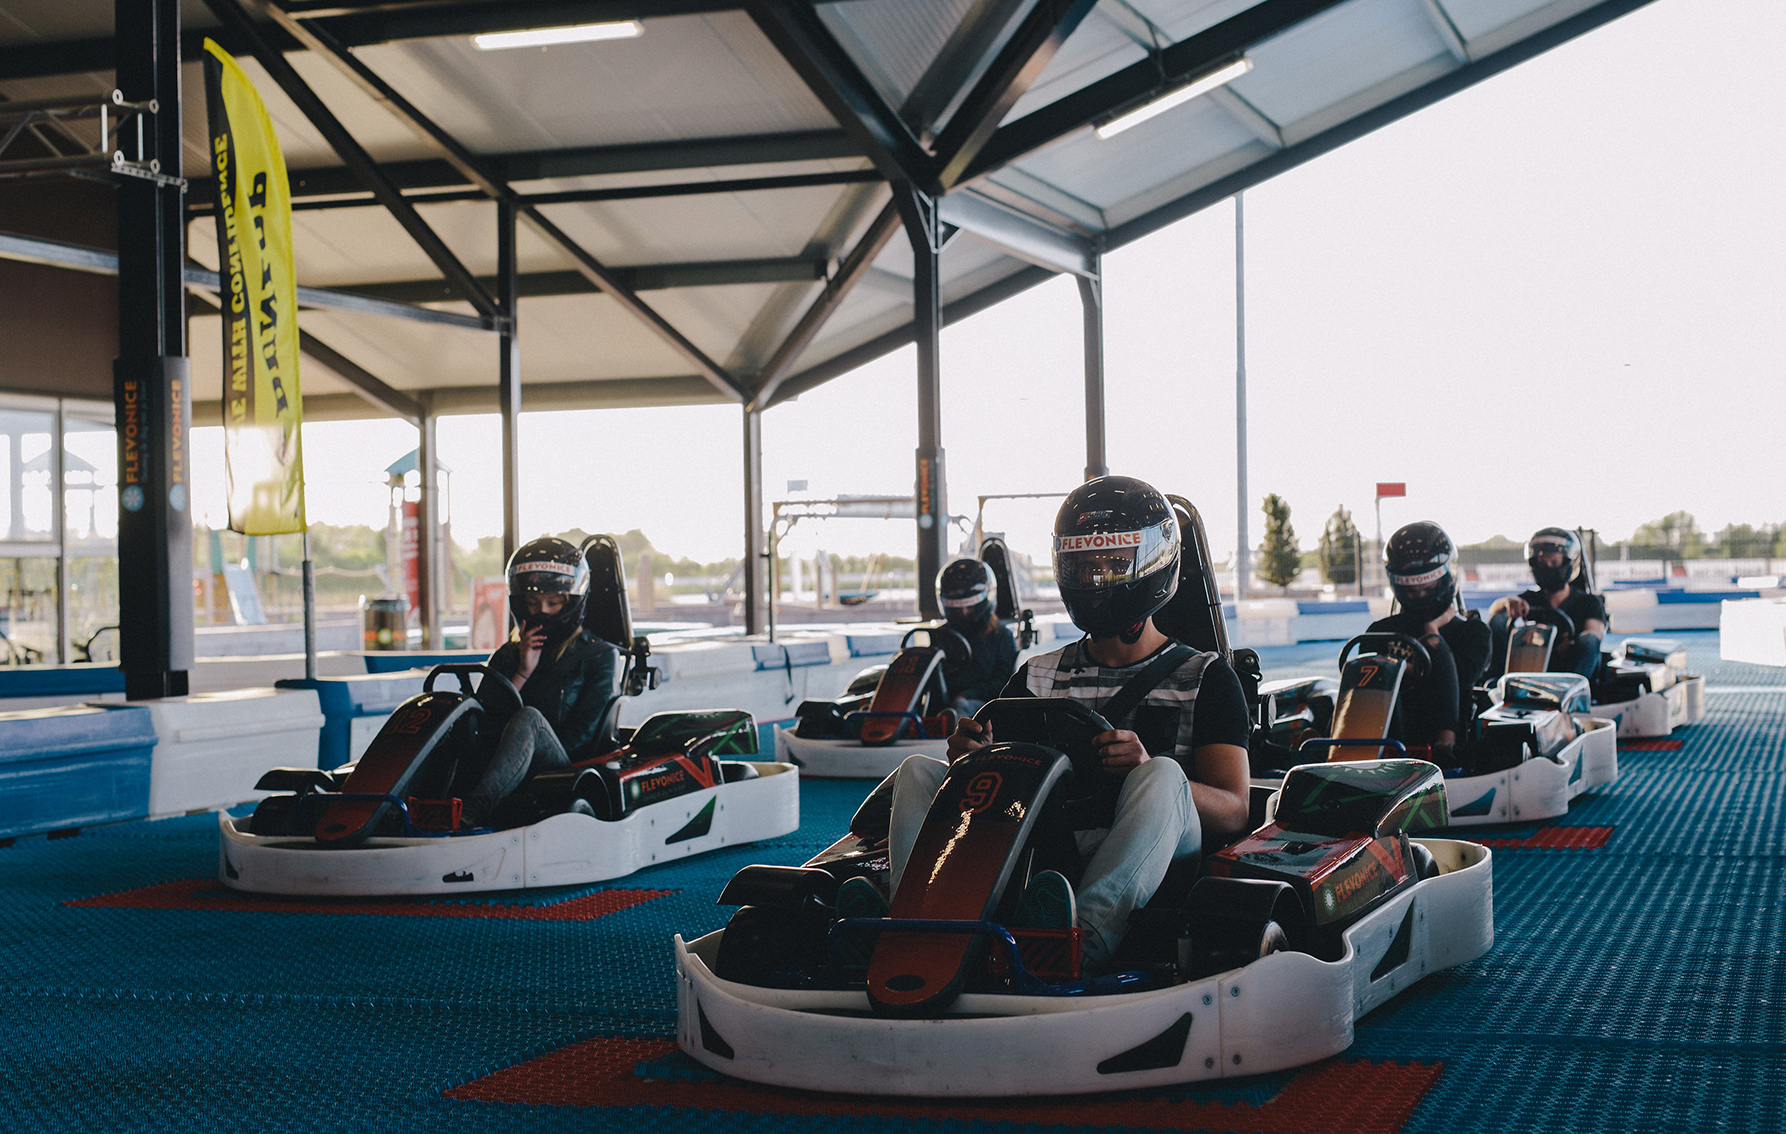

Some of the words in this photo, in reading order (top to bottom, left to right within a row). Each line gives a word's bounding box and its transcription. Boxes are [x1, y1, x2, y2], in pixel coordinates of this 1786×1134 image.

[124, 379, 139, 484] FLEVONICE
[171, 379, 183, 484] FLEVONICE
[1062, 532, 1141, 550] FLEVONICE
[517, 562, 571, 574] FLEVONICE
[1357, 665, 1379, 687] 7
[384, 708, 432, 734] 12
[975, 754, 1042, 766] FLEVONICE
[641, 770, 685, 793] FLEVONICE
[959, 772, 1003, 813] 9
[1335, 860, 1379, 903] FLEVONICE
